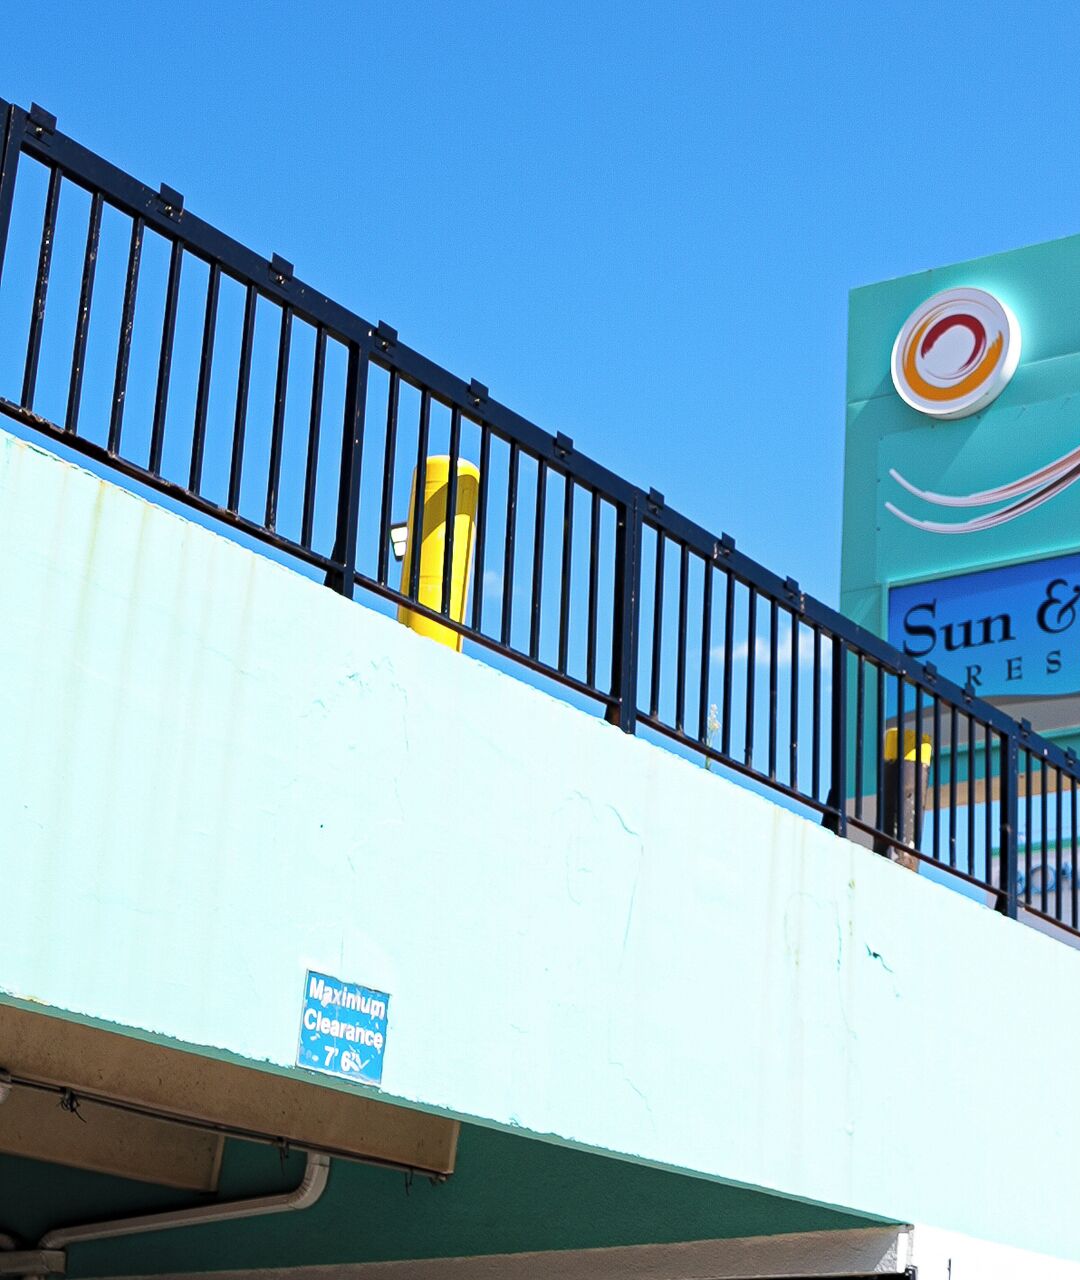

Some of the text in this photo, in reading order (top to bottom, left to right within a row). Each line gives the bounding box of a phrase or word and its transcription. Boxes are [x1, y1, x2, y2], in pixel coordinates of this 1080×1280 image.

[902, 598, 1016, 658] Sun
[309, 977, 386, 1020] Maximum
[304, 1008, 384, 1049] Clearance
